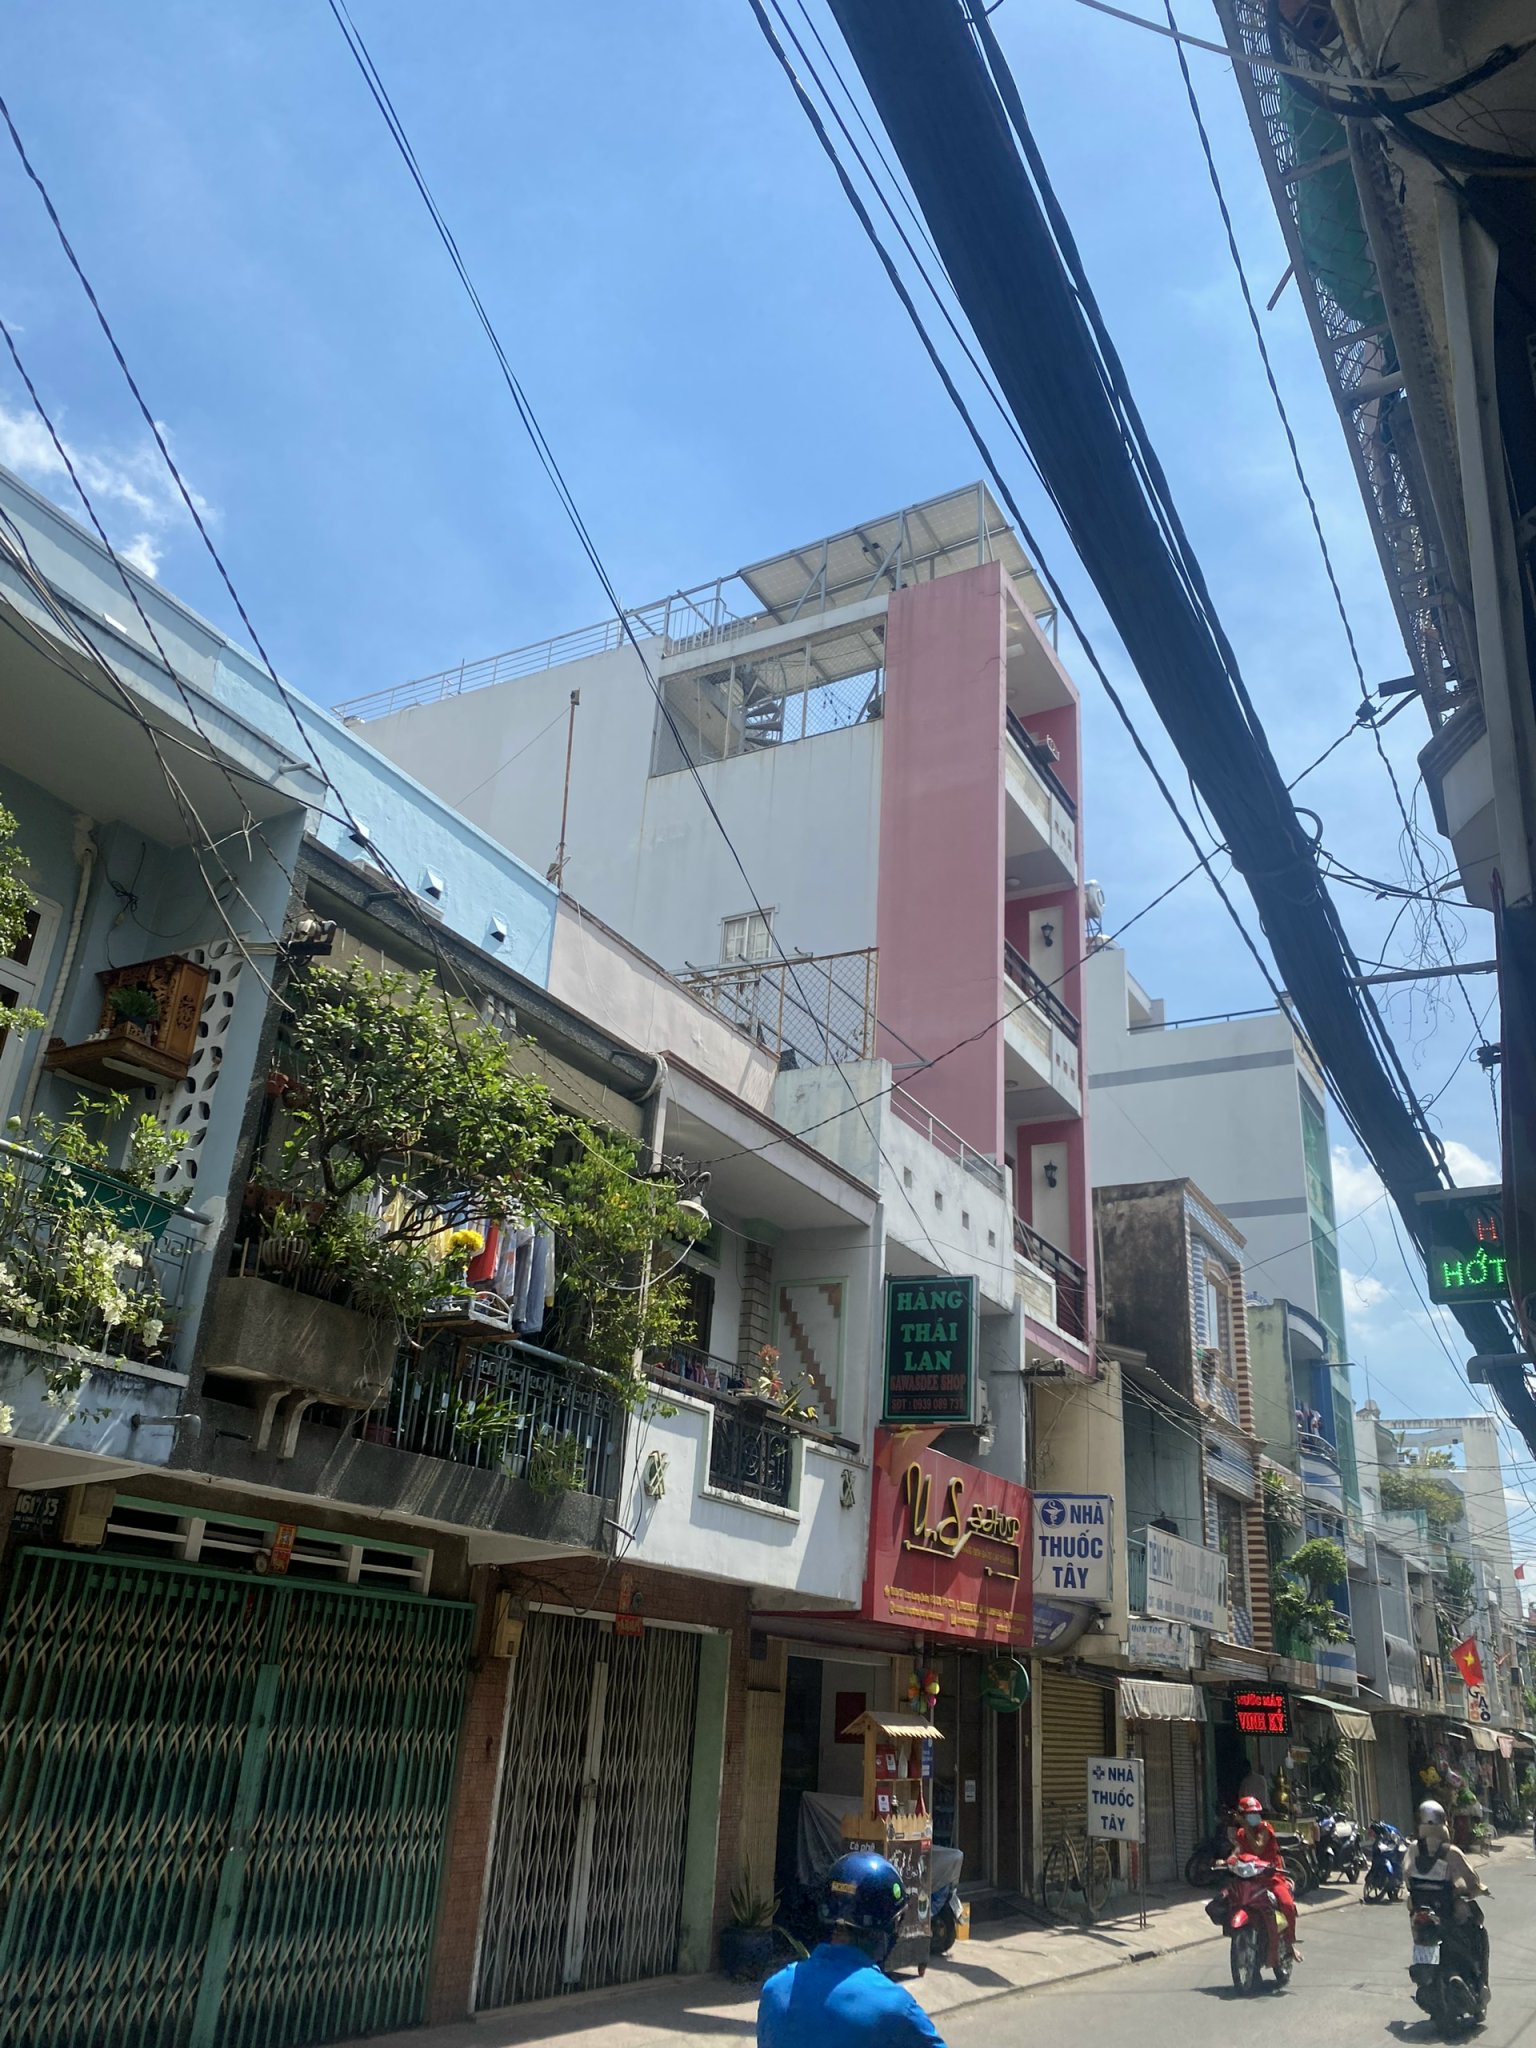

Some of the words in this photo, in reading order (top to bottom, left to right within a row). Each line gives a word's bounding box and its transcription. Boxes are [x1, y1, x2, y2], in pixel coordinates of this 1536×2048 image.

[897, 1286, 963, 1311] HÀNG
[900, 1317, 958, 1343] THÁI
[904, 1350, 952, 1371] LAN
[940, 1374, 966, 1391] SHOP
[1070, 1501, 1104, 1525] NHÀ
[1038, 1529, 1103, 1559] THUỐC
[1052, 1562, 1089, 1589] TÂY
[1108, 1764, 1135, 1782] NHÀ
[1091, 1787, 1134, 1808] THUỐC
[1101, 1813, 1126, 1831] TÂY
